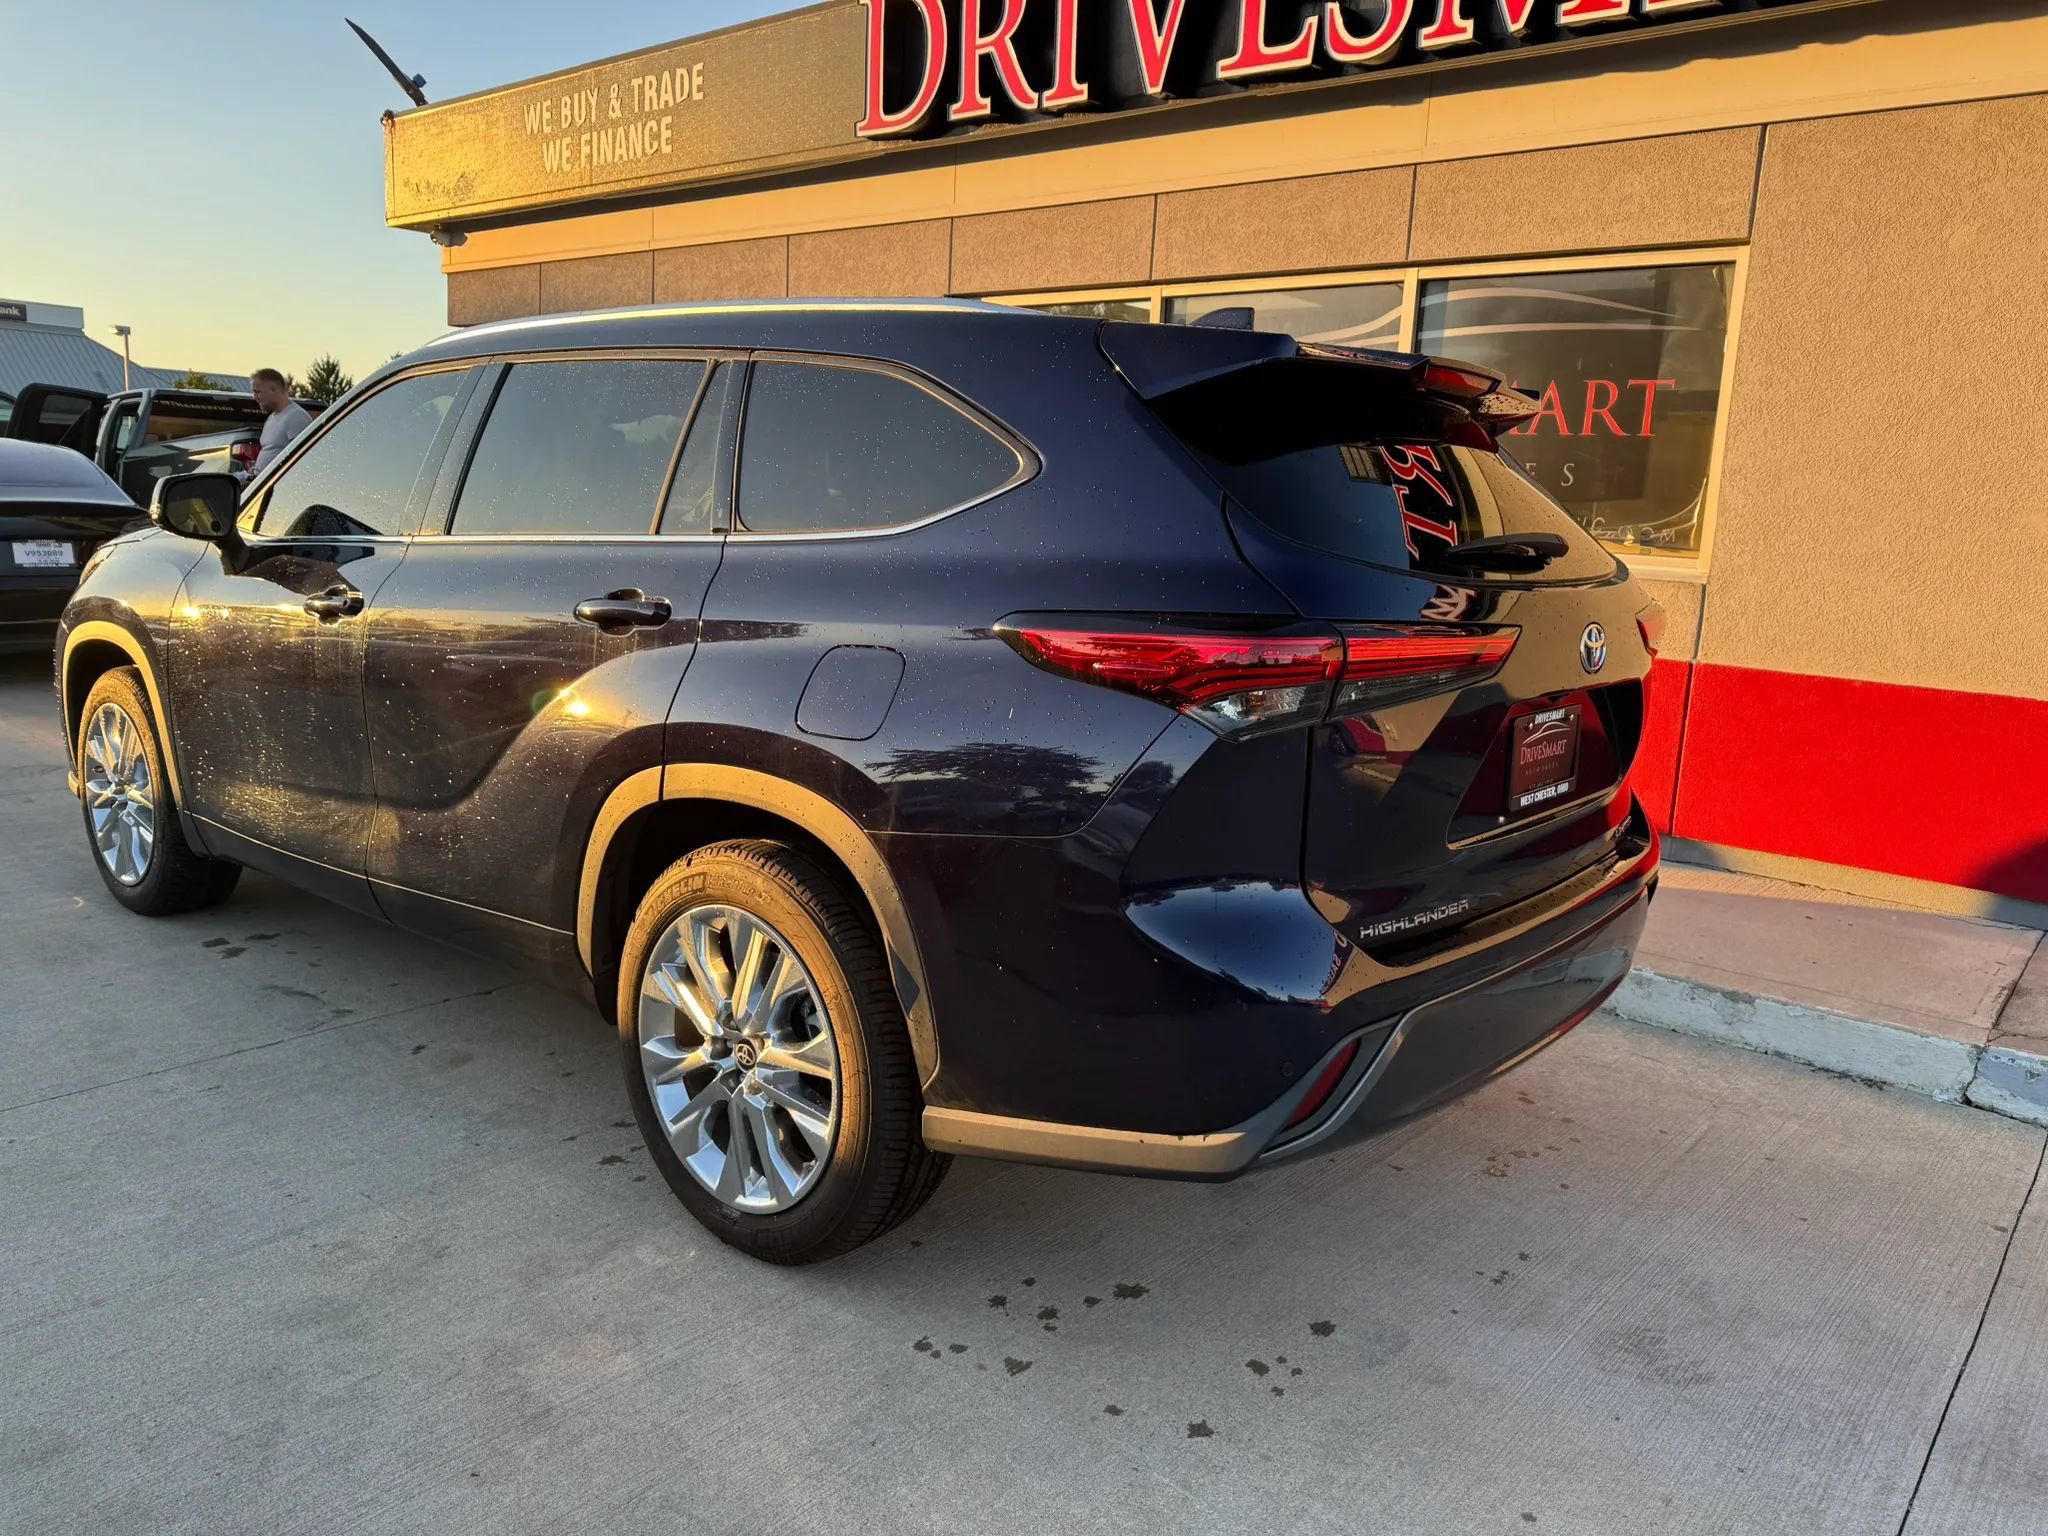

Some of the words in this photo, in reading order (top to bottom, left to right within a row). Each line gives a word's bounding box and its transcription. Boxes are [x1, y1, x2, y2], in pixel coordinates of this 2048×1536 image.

[523, 101, 552, 135] WE
[561, 87, 599, 128] BUY
[608, 83, 622, 119] &
[631, 62, 704, 113] TRADE
[542, 137, 572, 174] WE
[580, 115, 673, 169] FINANCE
[1520, 795, 1535, 807] WEST
[1535, 786, 1557, 803] CHESTER,
[1360, 899, 1469, 938] HIGHLANDER
